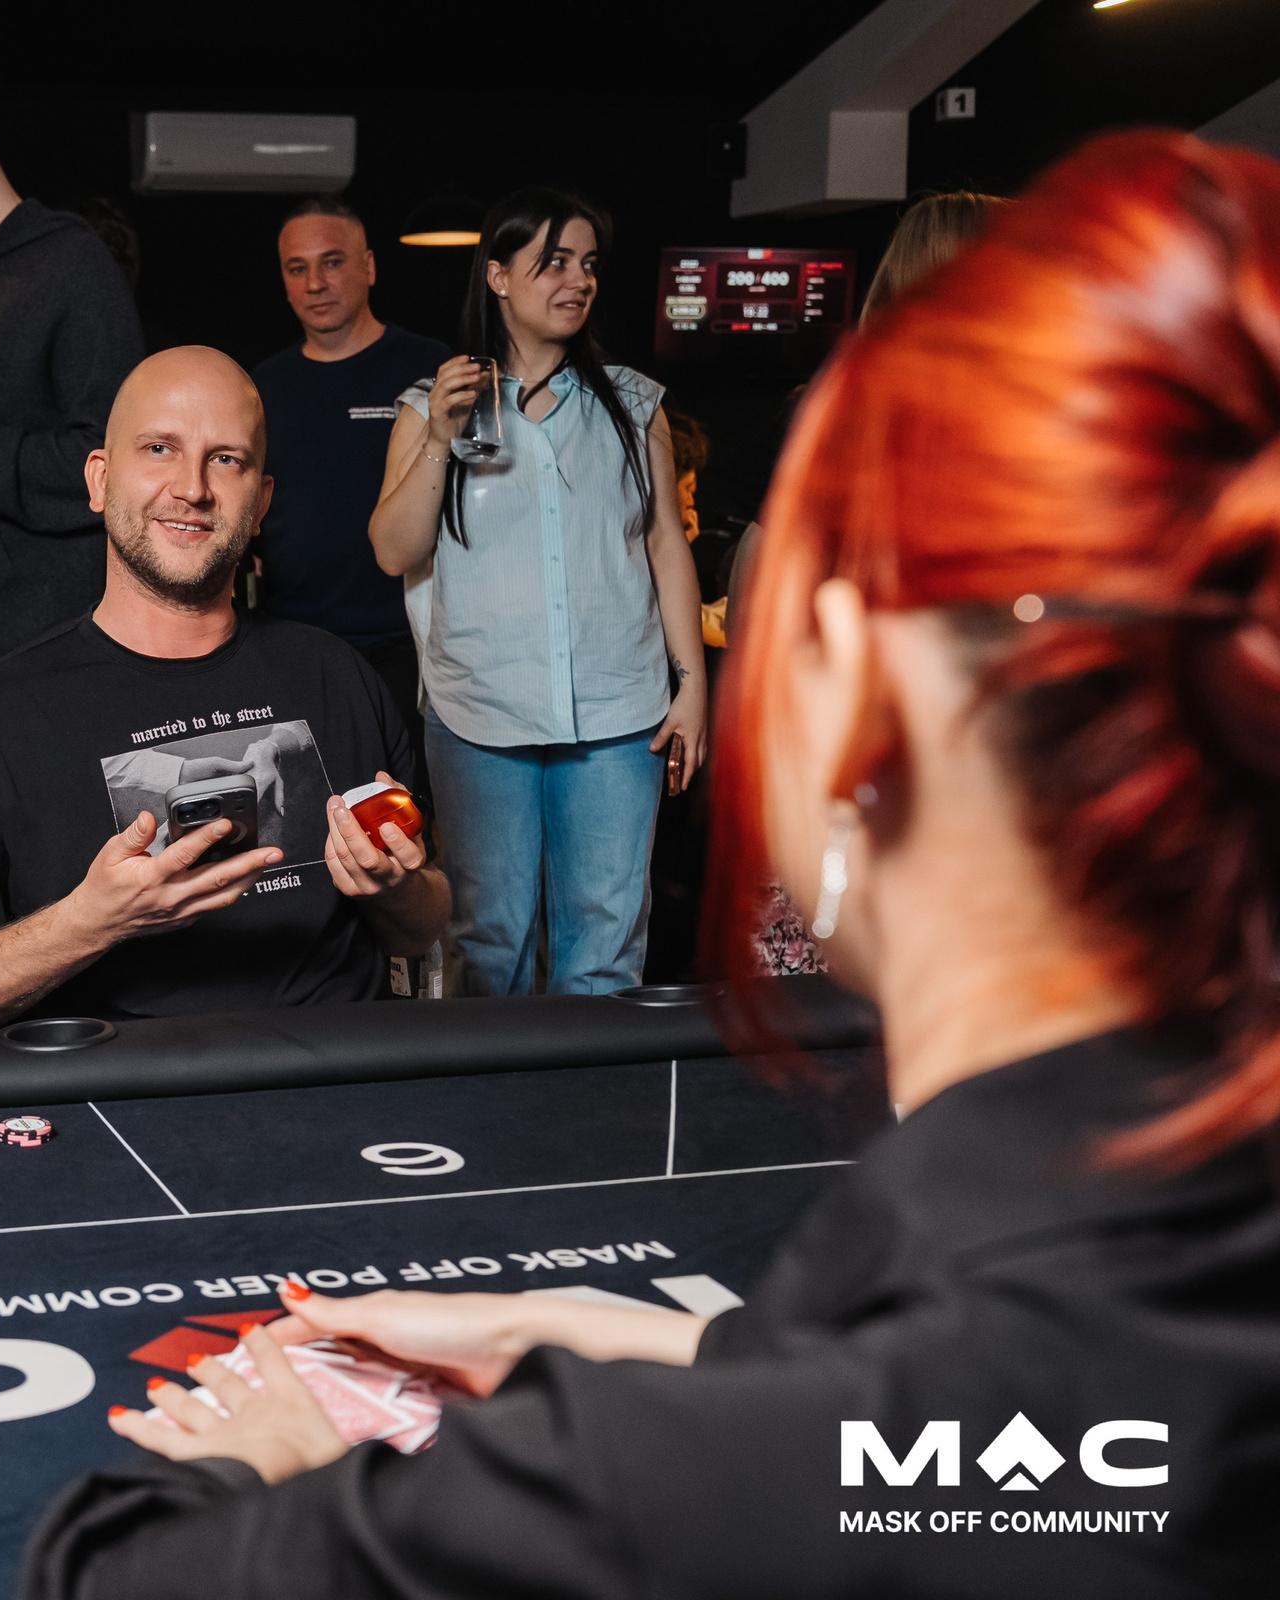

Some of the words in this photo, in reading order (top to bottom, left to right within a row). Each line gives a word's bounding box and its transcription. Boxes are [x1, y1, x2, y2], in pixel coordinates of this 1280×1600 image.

[954, 93, 966, 113] 1
[131, 719, 187, 744] married
[192, 717, 207, 730] to
[211, 710, 232, 728] the
[236, 705, 274, 723] street
[254, 871, 302, 894] russia
[360, 1142, 465, 1176] 6
[399, 1256, 503, 1282] OFF
[507, 1240, 676, 1272] MASK
